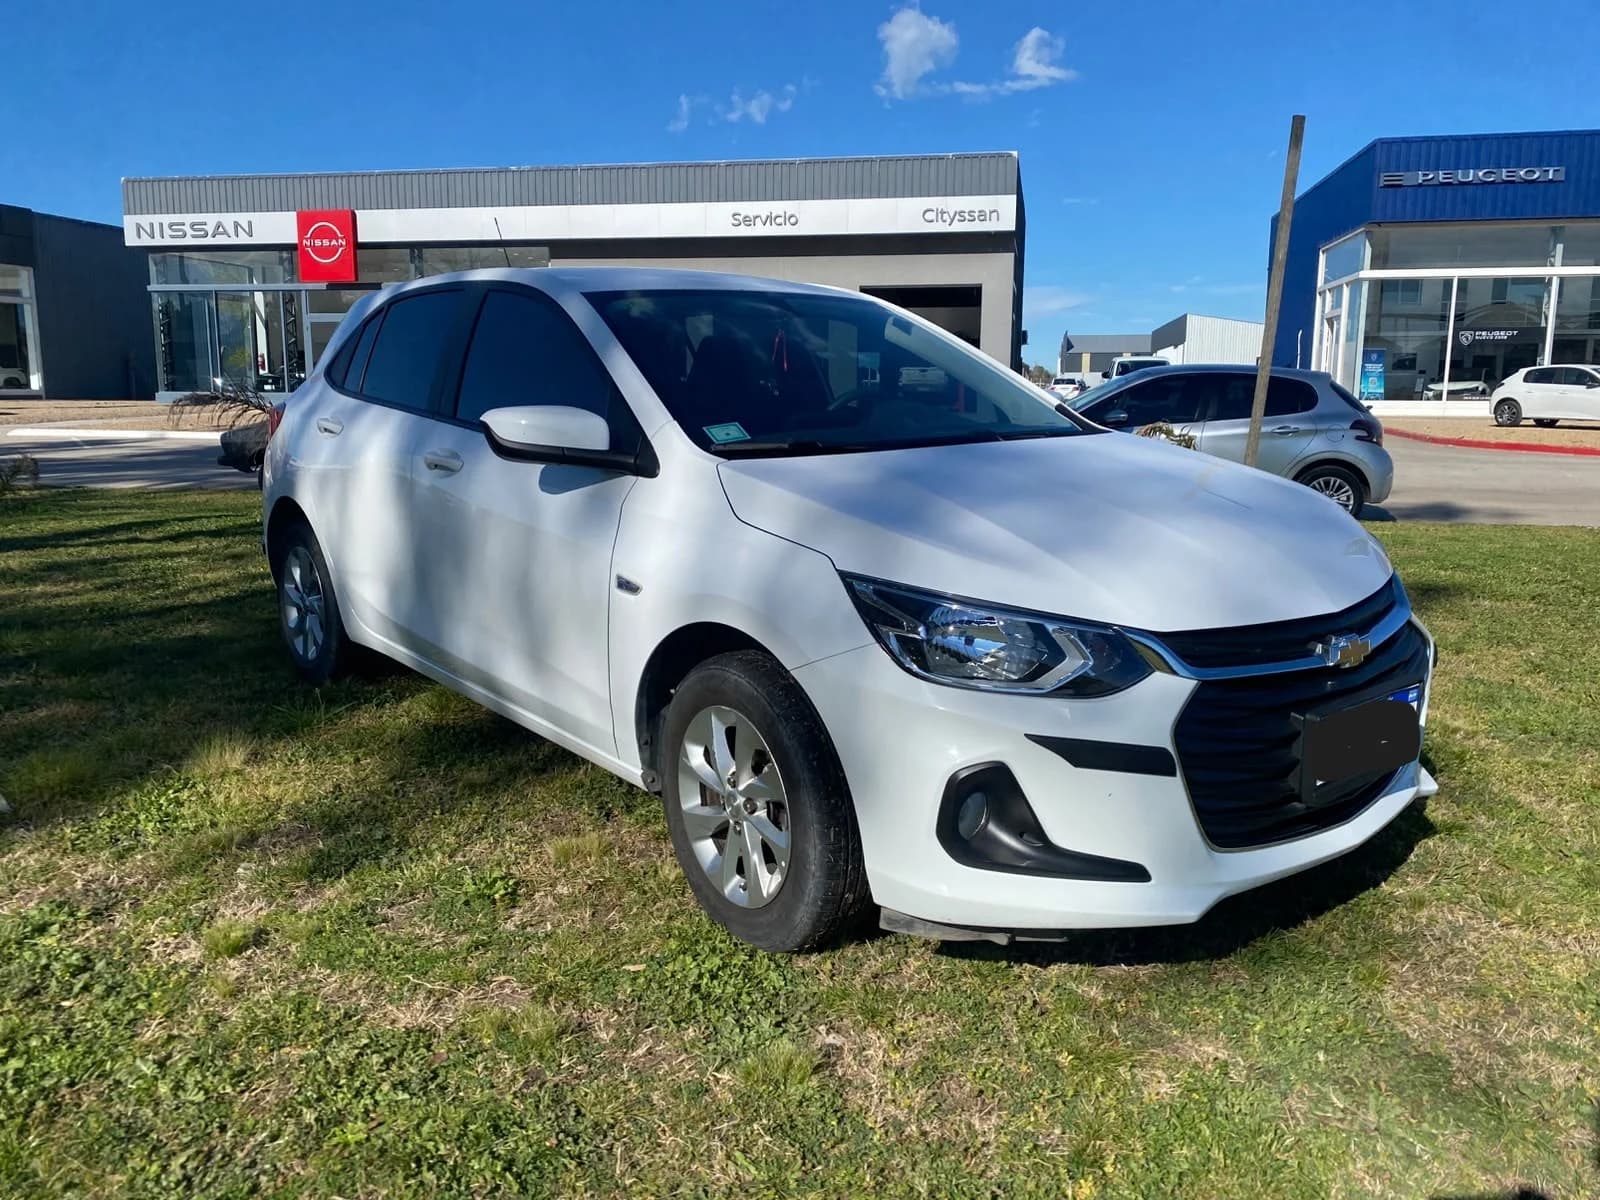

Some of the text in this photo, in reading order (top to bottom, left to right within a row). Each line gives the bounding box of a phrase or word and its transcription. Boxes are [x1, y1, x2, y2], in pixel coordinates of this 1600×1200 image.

[1418, 167, 1561, 184] PEUGEOT
[731, 212, 799, 227] Servicio
[922, 207, 1000, 225] Cityssan
[135, 220, 254, 239] NISSAN
[303, 239, 346, 247] NISSAN
